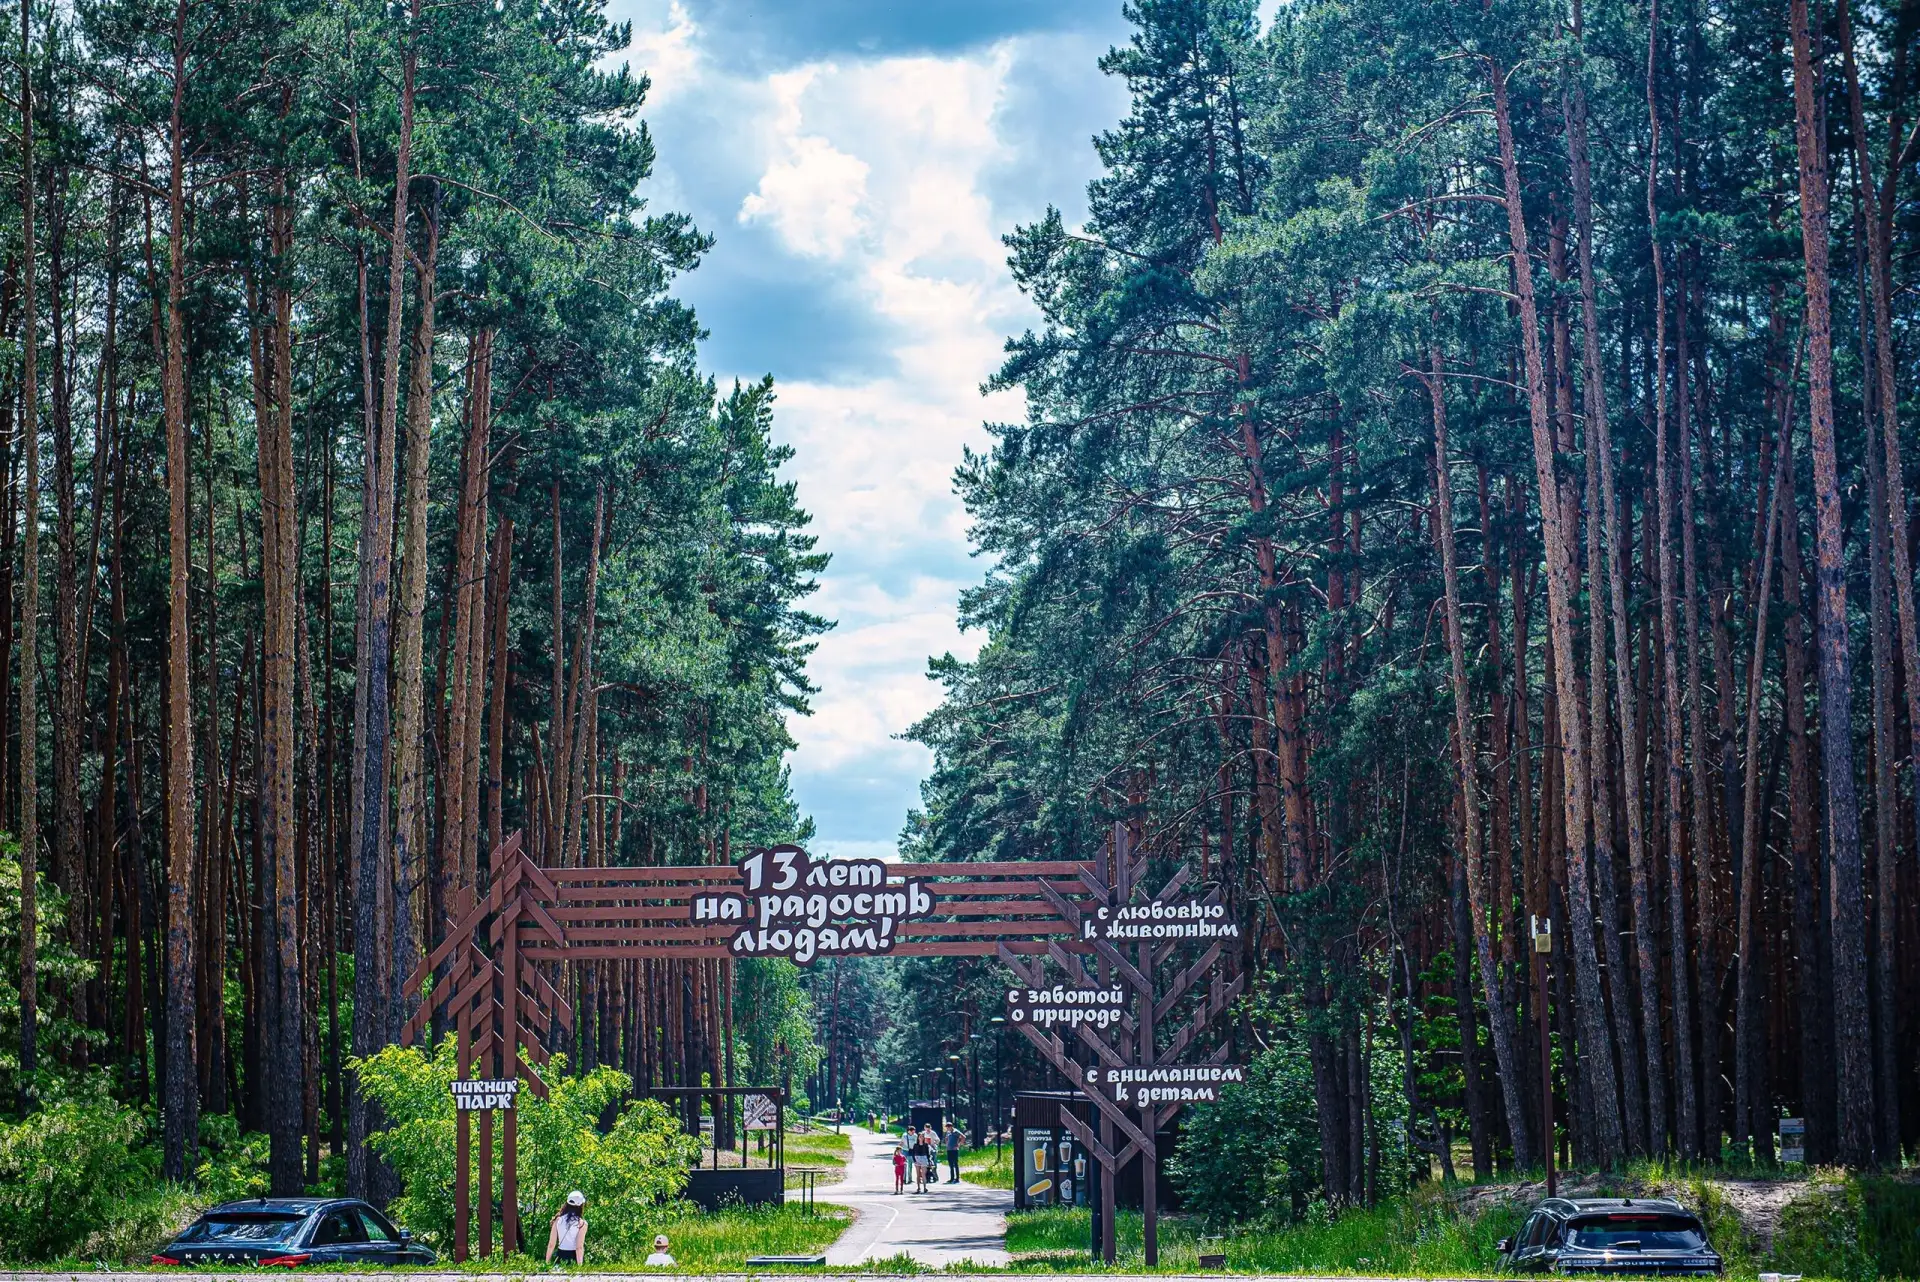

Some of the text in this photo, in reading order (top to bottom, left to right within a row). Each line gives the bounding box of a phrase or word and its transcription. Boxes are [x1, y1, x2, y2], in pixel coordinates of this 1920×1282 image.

[744, 851, 882, 891] 13 лет
[696, 883, 930, 928] на радость
[1098, 900, 1224, 919] с любовью
[1084, 919, 1239, 939] к животным
[733, 917, 892, 962] людям!
[1008, 984, 1123, 1004] с заботой
[1011, 1007, 1121, 1028] о природе
[1087, 1066, 1243, 1083] с вниманием
[456, 1094, 512, 1109] ПАРК
[1116, 1083, 1215, 1107] к детям
